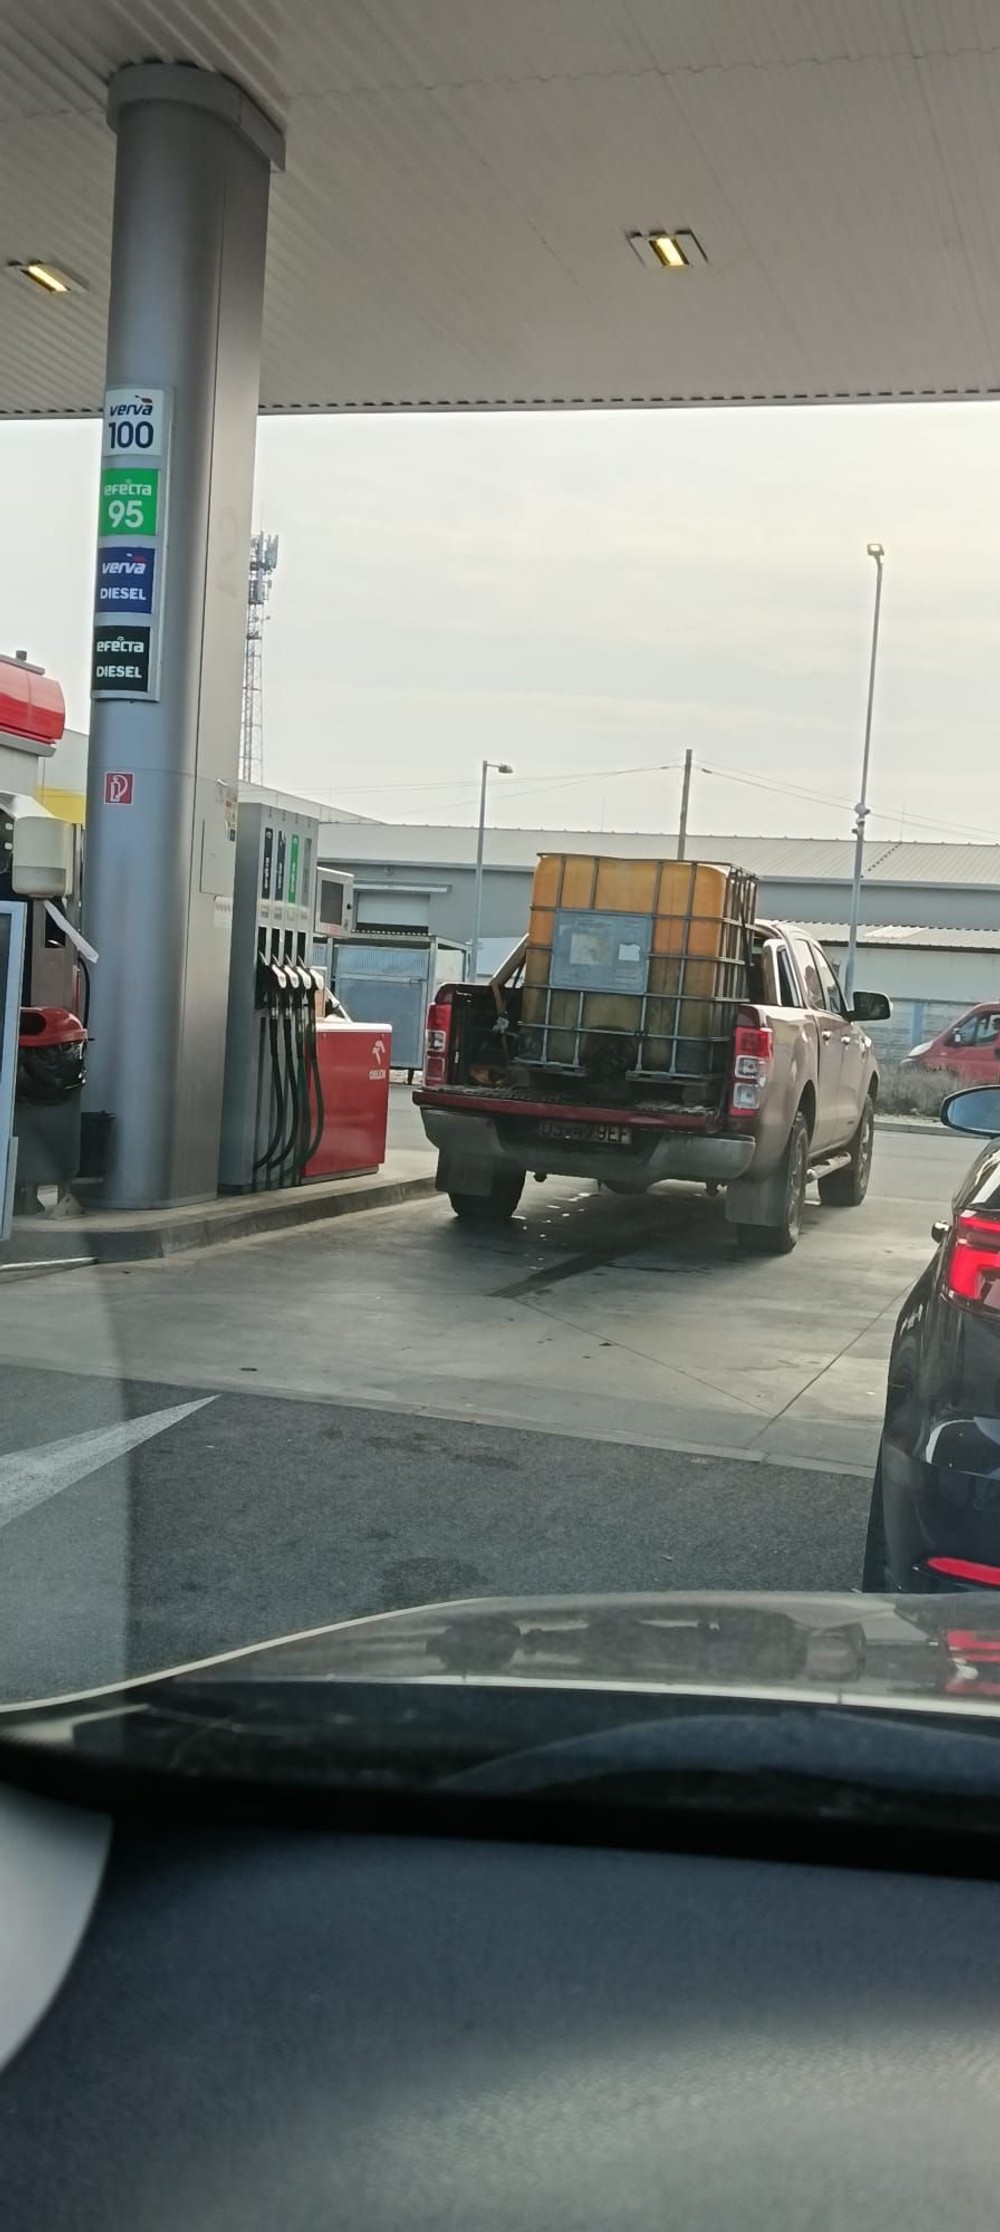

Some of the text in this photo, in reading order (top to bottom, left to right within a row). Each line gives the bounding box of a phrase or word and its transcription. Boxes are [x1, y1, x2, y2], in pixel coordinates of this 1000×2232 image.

[110, 404, 154, 417] verva
[108, 421, 154, 449] 100
[108, 500, 144, 528] 95
[102, 562, 146, 575] verva
[100, 587, 147, 600] DIESEL
[96, 665, 142, 678] DIESEL
